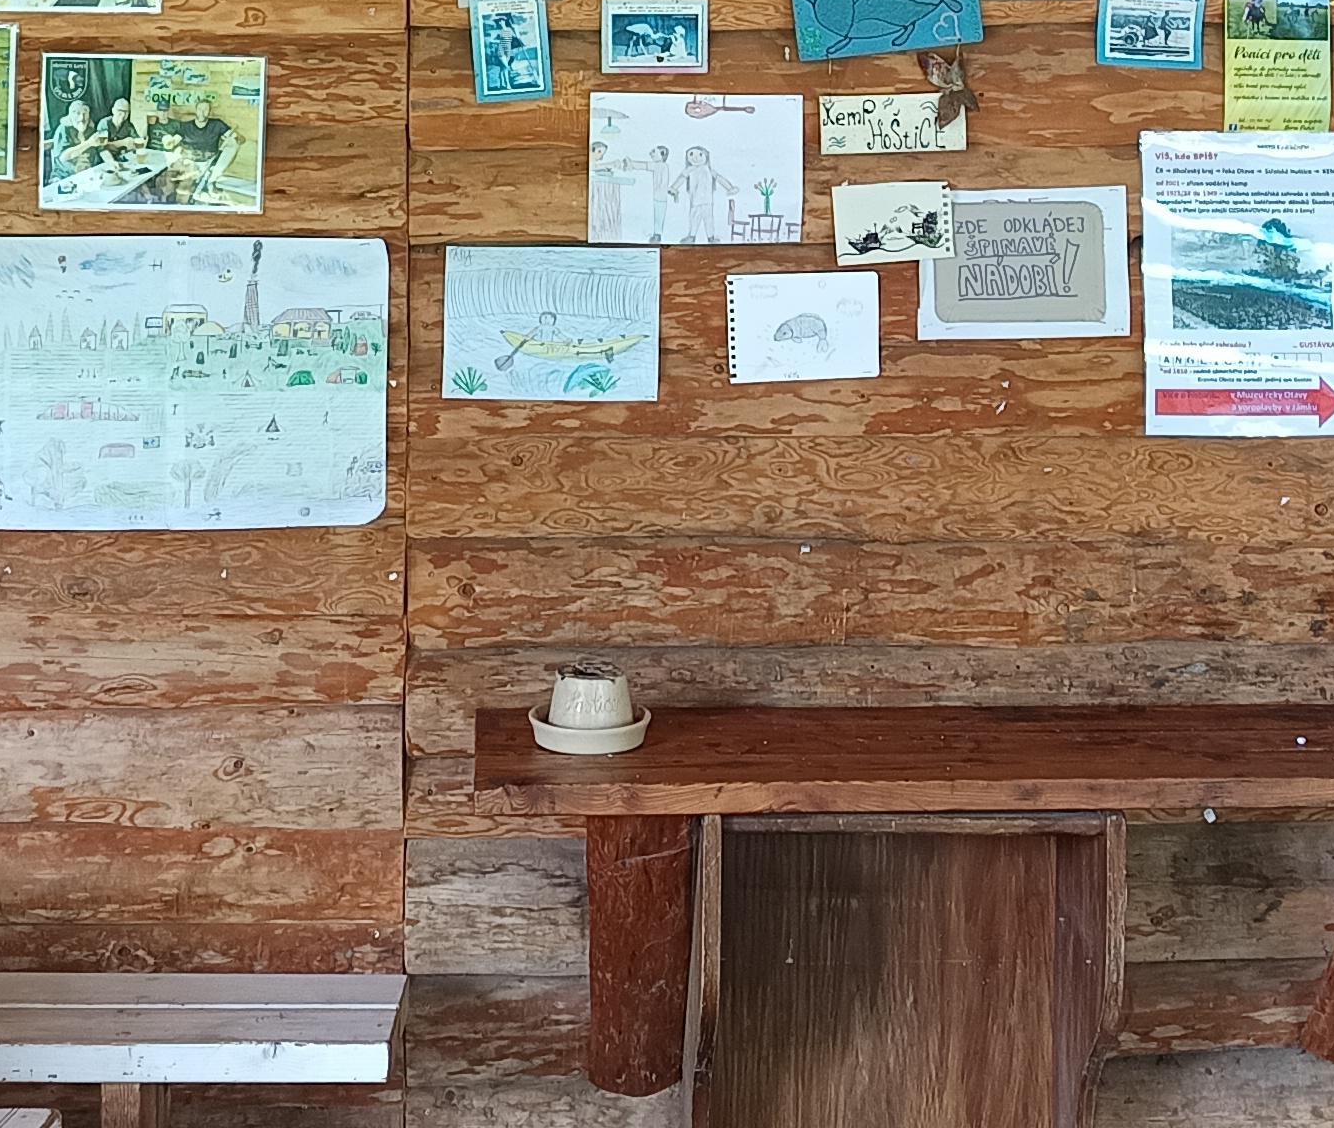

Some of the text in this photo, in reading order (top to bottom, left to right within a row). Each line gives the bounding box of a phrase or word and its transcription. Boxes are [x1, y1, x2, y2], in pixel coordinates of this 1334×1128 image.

[1273, 50, 1295, 64] pro
[1299, 48, 1321, 64] děti
[955, 211, 1085, 234] ZDE ODKLÁDEJ
[964, 232, 1056, 256] ŠPINAVÉ
